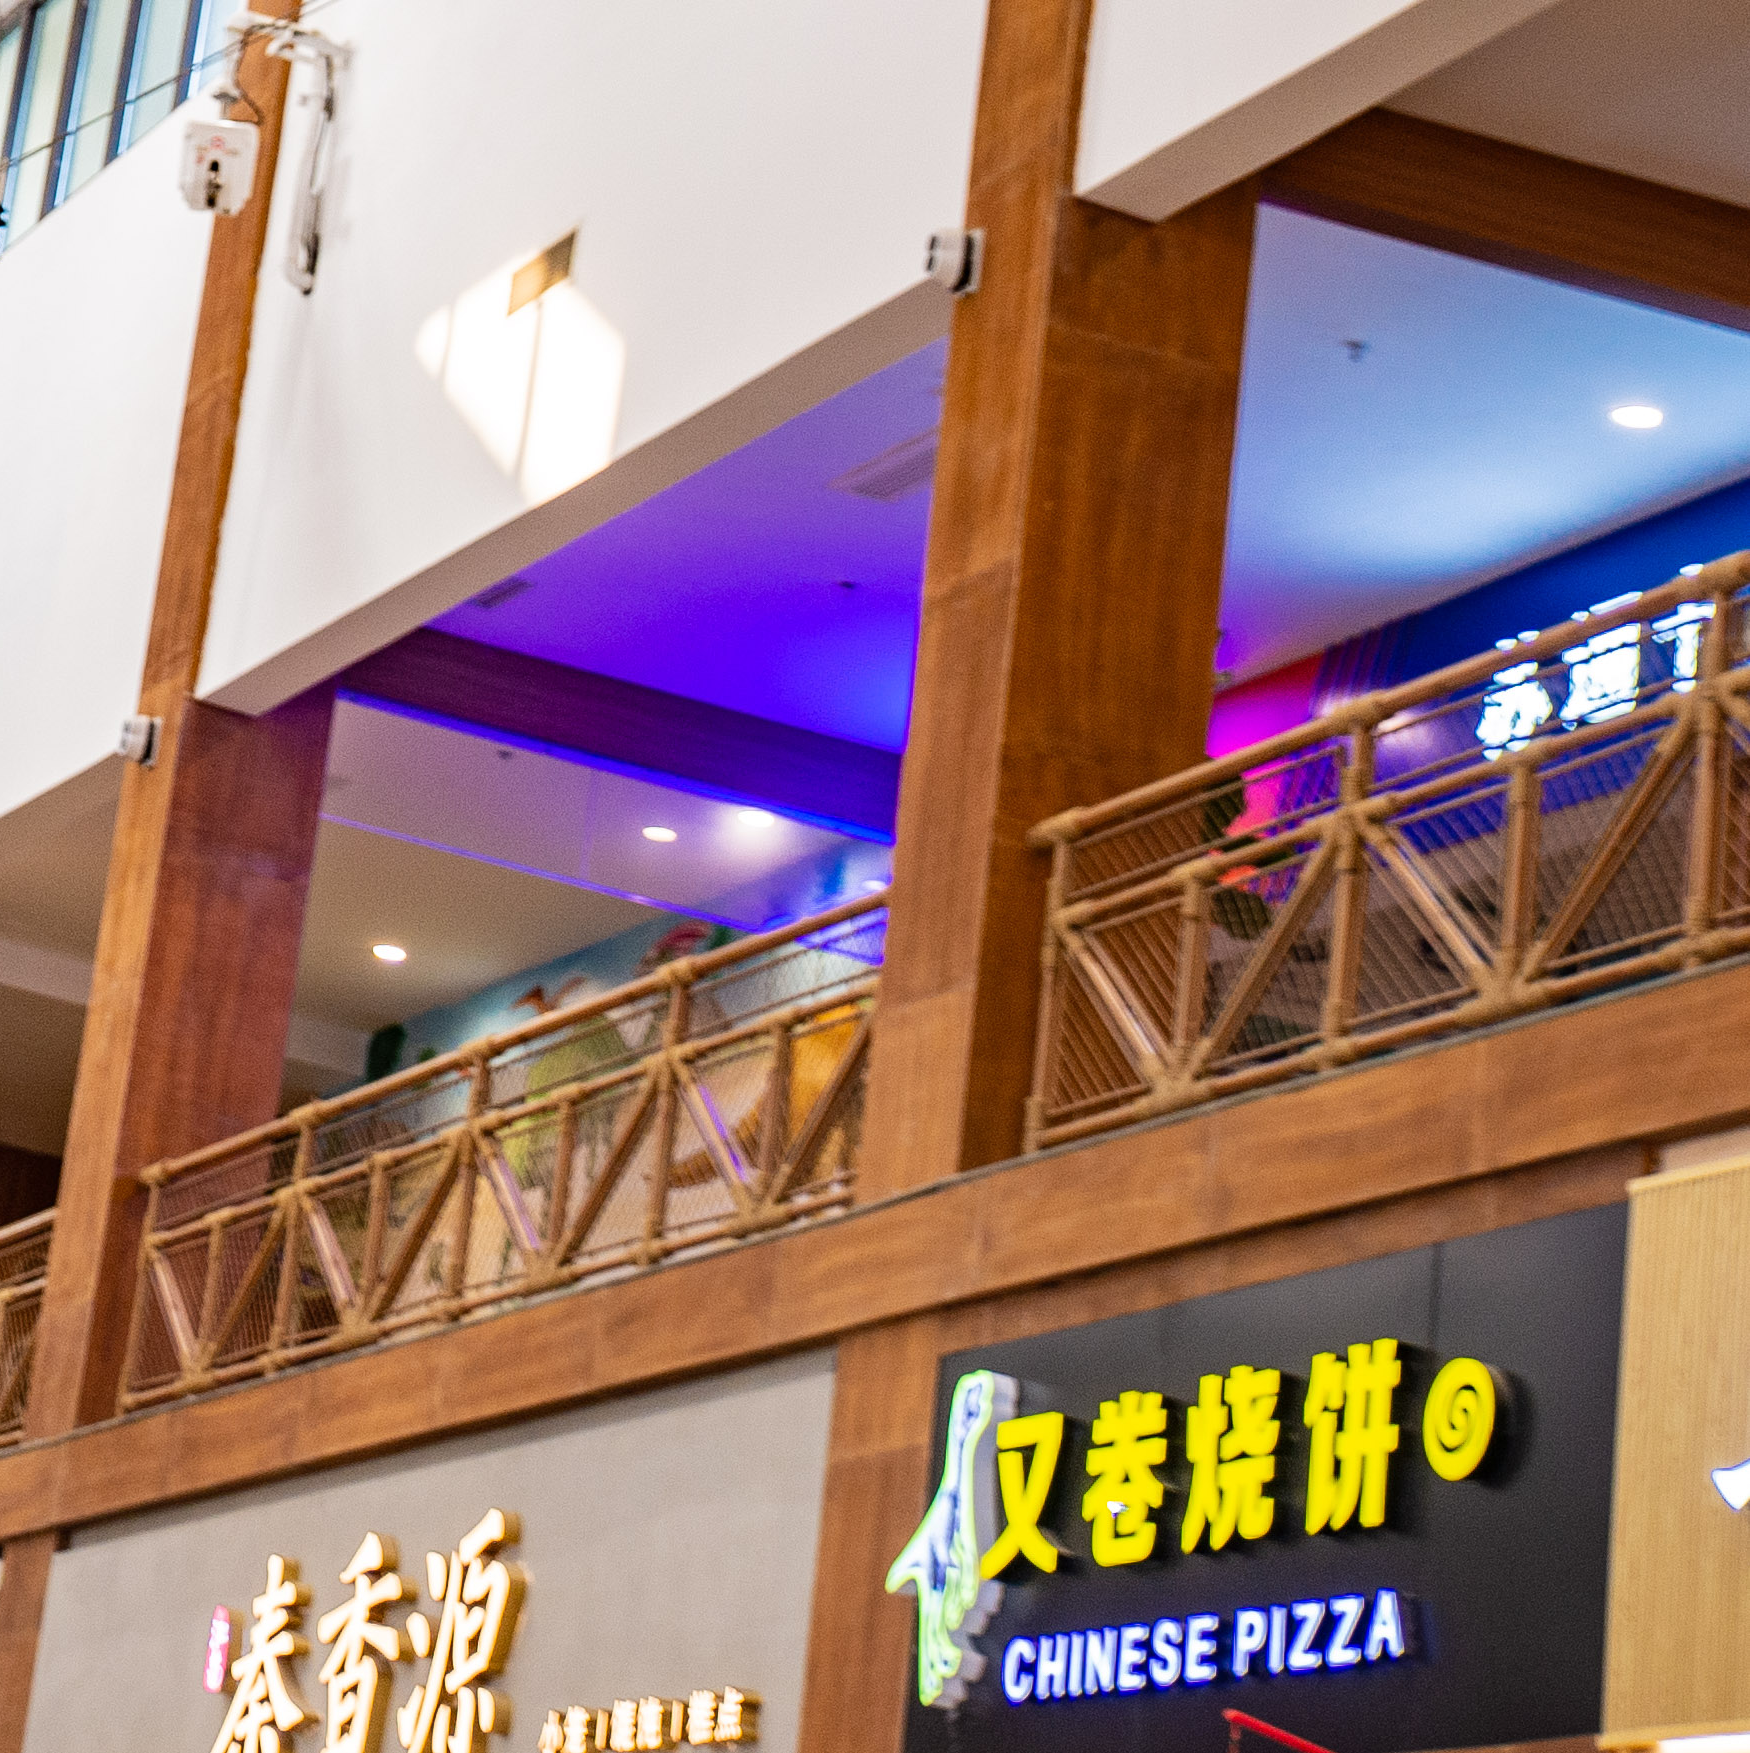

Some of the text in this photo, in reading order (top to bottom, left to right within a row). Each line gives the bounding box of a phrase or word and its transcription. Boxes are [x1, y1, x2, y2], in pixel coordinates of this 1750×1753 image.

[980, 1337, 1402, 1581] 又卷烧饼
[1001, 1587, 1406, 1708] CHINESE PIZZA
